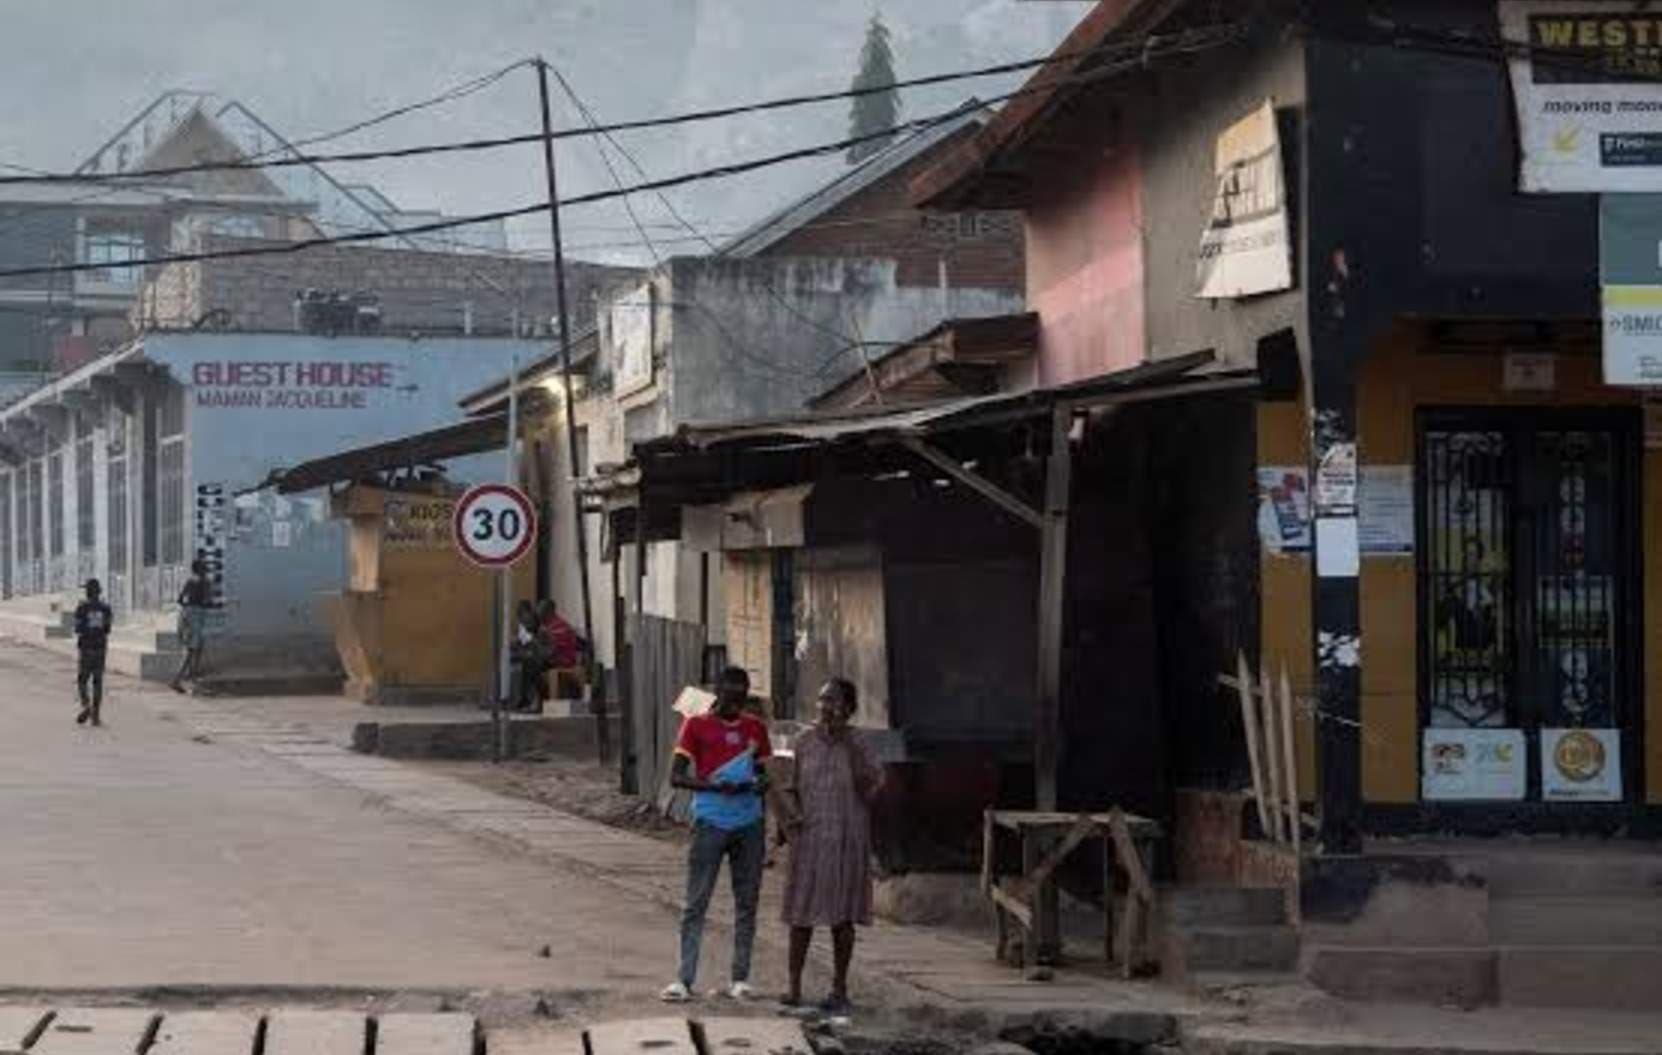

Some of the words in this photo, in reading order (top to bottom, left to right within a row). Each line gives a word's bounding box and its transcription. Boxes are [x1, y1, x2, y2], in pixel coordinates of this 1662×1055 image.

[192, 361, 292, 387] GUEST
[295, 361, 394, 388] HOUSE
[196, 389, 262, 407] MAMAN
[264, 389, 367, 408] JACQUELINE
[473, 507, 520, 541] 30
